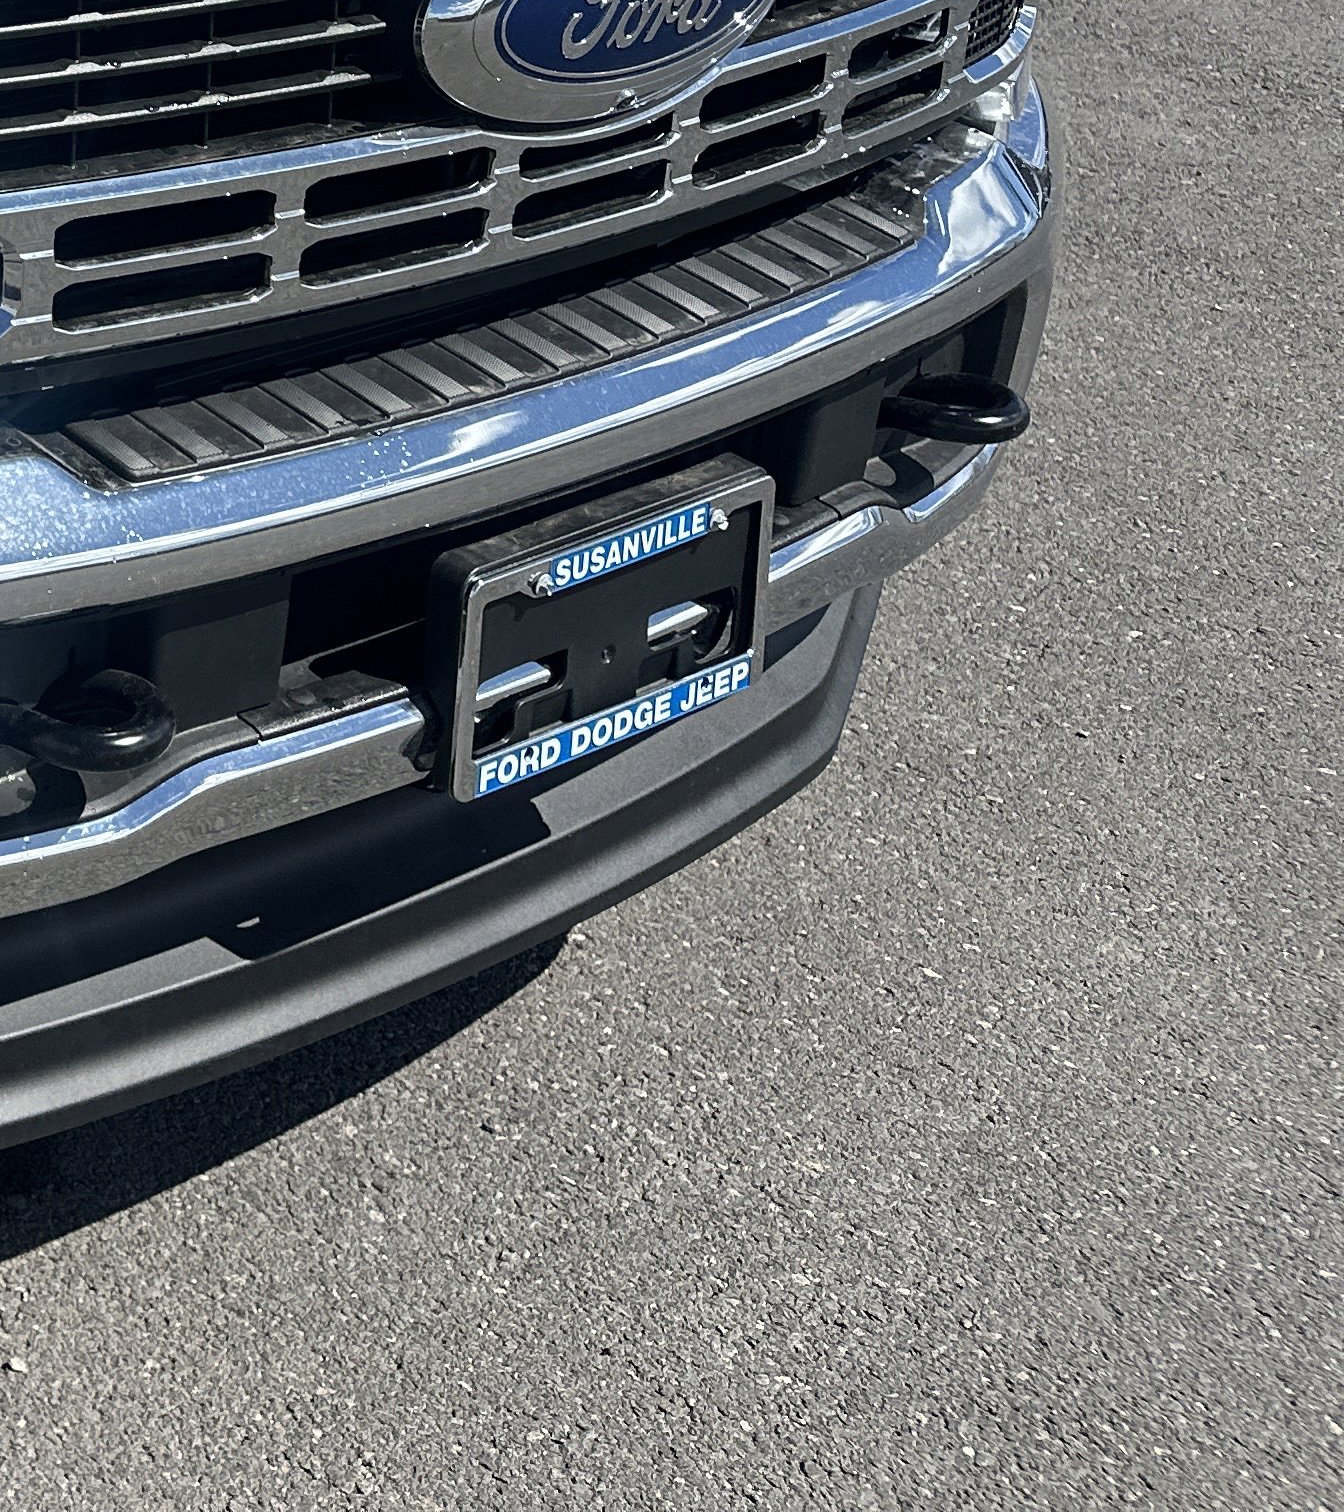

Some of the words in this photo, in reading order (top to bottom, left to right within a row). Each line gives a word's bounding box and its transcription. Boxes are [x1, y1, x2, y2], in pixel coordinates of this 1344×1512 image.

[555, 507, 706, 587] SUSANVILLE
[478, 738, 561, 794] FORD
[570, 698, 672, 758] DODGE
[679, 662, 750, 713] JEEP
